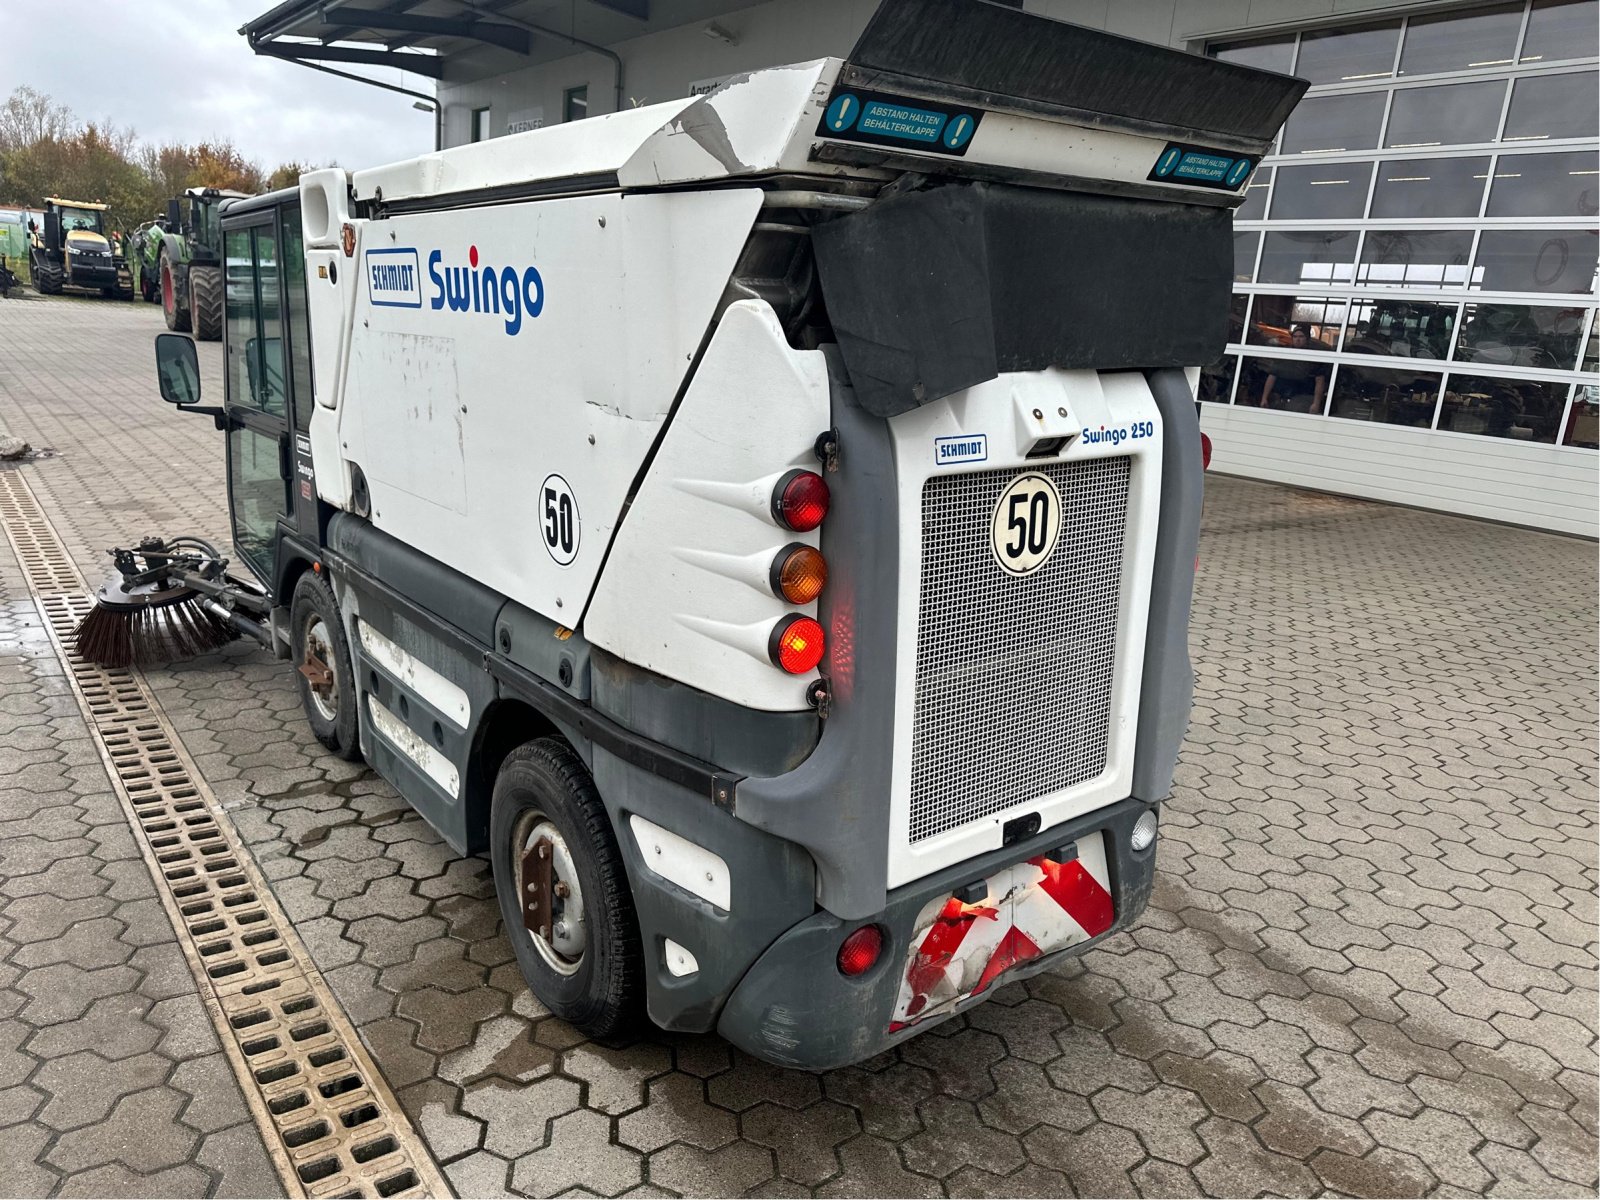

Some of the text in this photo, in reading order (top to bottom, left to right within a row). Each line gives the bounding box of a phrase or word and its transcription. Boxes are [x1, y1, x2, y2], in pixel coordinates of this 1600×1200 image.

[869, 106, 941, 125] ABSTAND HALTEN
[864, 118, 936, 137] BEHÄLTERKLAPPE
[1178, 165, 1224, 177] BEHÄLTERKLAPPE
[1186, 156, 1228, 168] ABSTAND HALTEN
[371, 264, 414, 292] SCHMIDT
[428, 244, 545, 336] Swingo
[1082, 421, 1154, 446] Swingo 250
[940, 441, 982, 458] SCHMIDT
[544, 486, 574, 554] 50
[1005, 490, 1050, 559] 50
